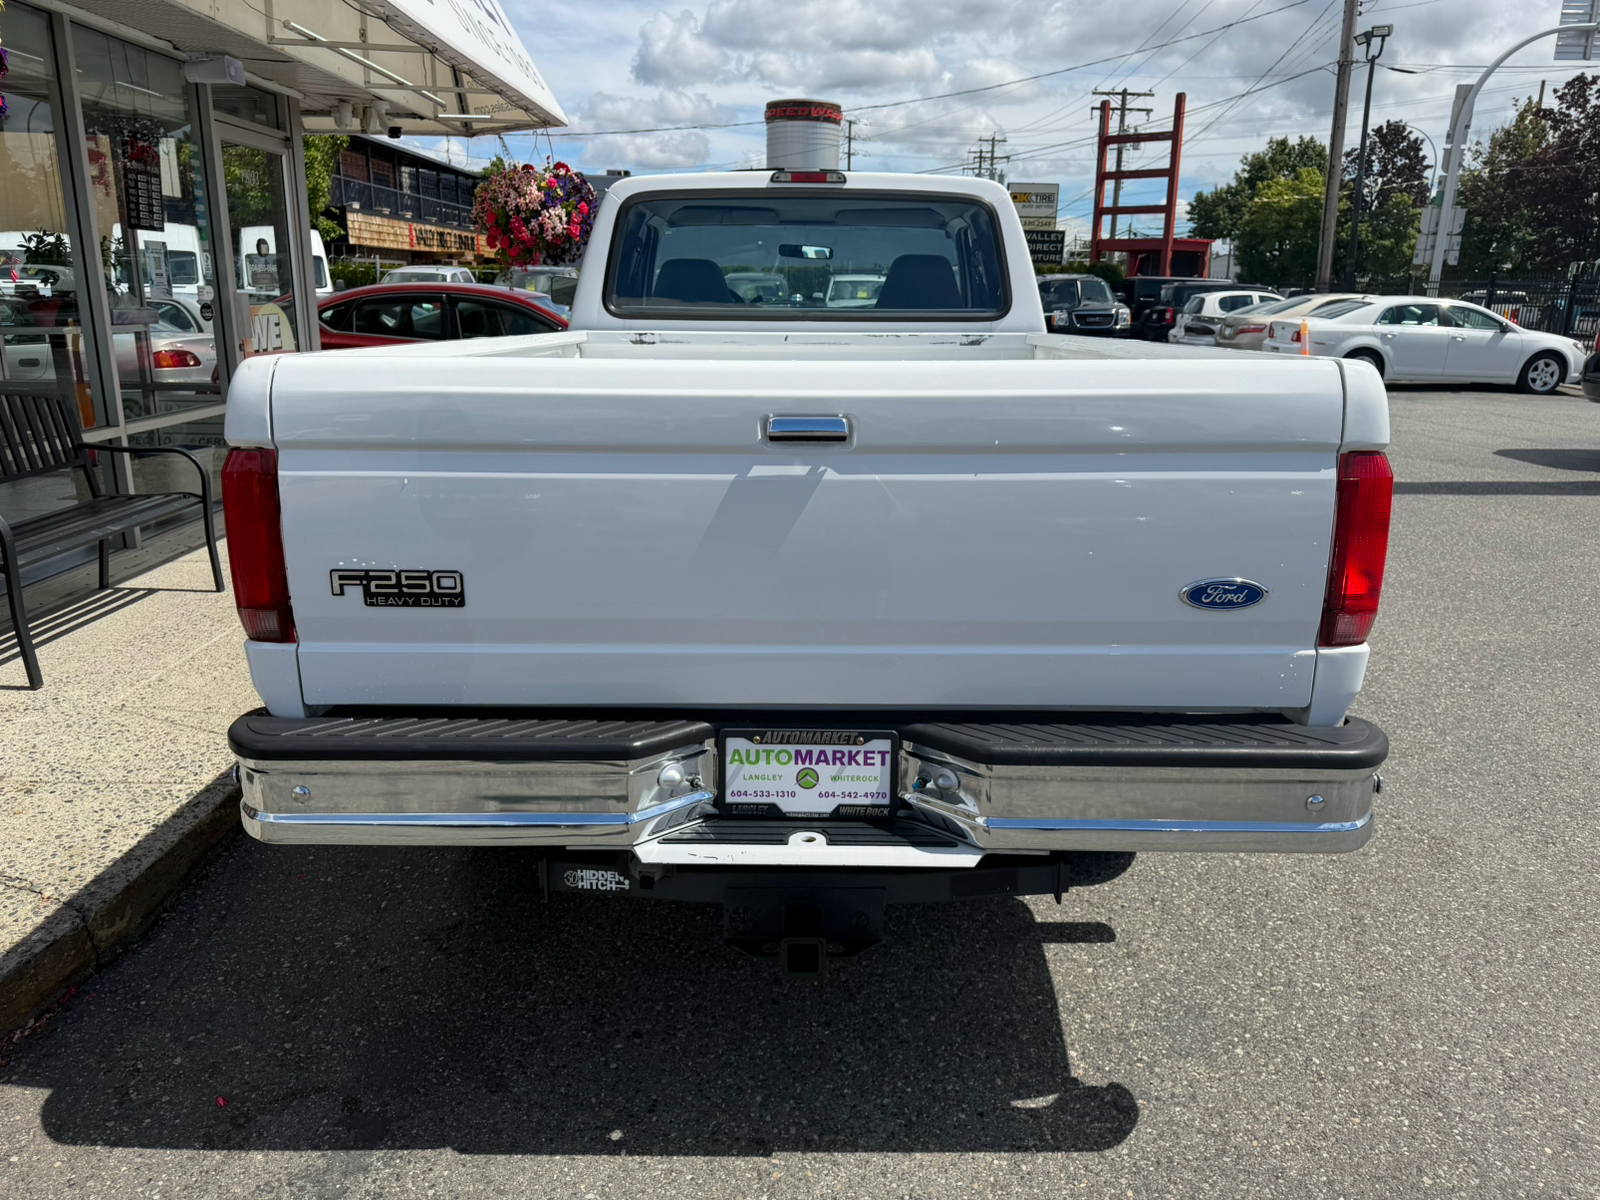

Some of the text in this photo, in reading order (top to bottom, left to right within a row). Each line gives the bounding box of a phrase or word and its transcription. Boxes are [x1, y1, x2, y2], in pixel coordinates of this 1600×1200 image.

[447, 0, 512, 65] SINCE
[1035, 194, 1053, 202] TIRE
[1026, 233, 1063, 241] VALLEY
[1028, 243, 1063, 251] DIRECT
[250, 313, 283, 353] WE
[1201, 585, 1249, 603] Ford
[367, 597, 461, 605] HEAVY DUTY
[762, 731, 859, 745] AUTOMARKET
[729, 749, 890, 766] AUTOMARKET
[730, 790, 796, 798] 604-533-1310
[818, 791, 887, 799] 604-542-4970
[732, 805, 768, 814] LANGLEY
[578, 870, 624, 881] HIDDEN
[578, 880, 616, 891] HITCH
